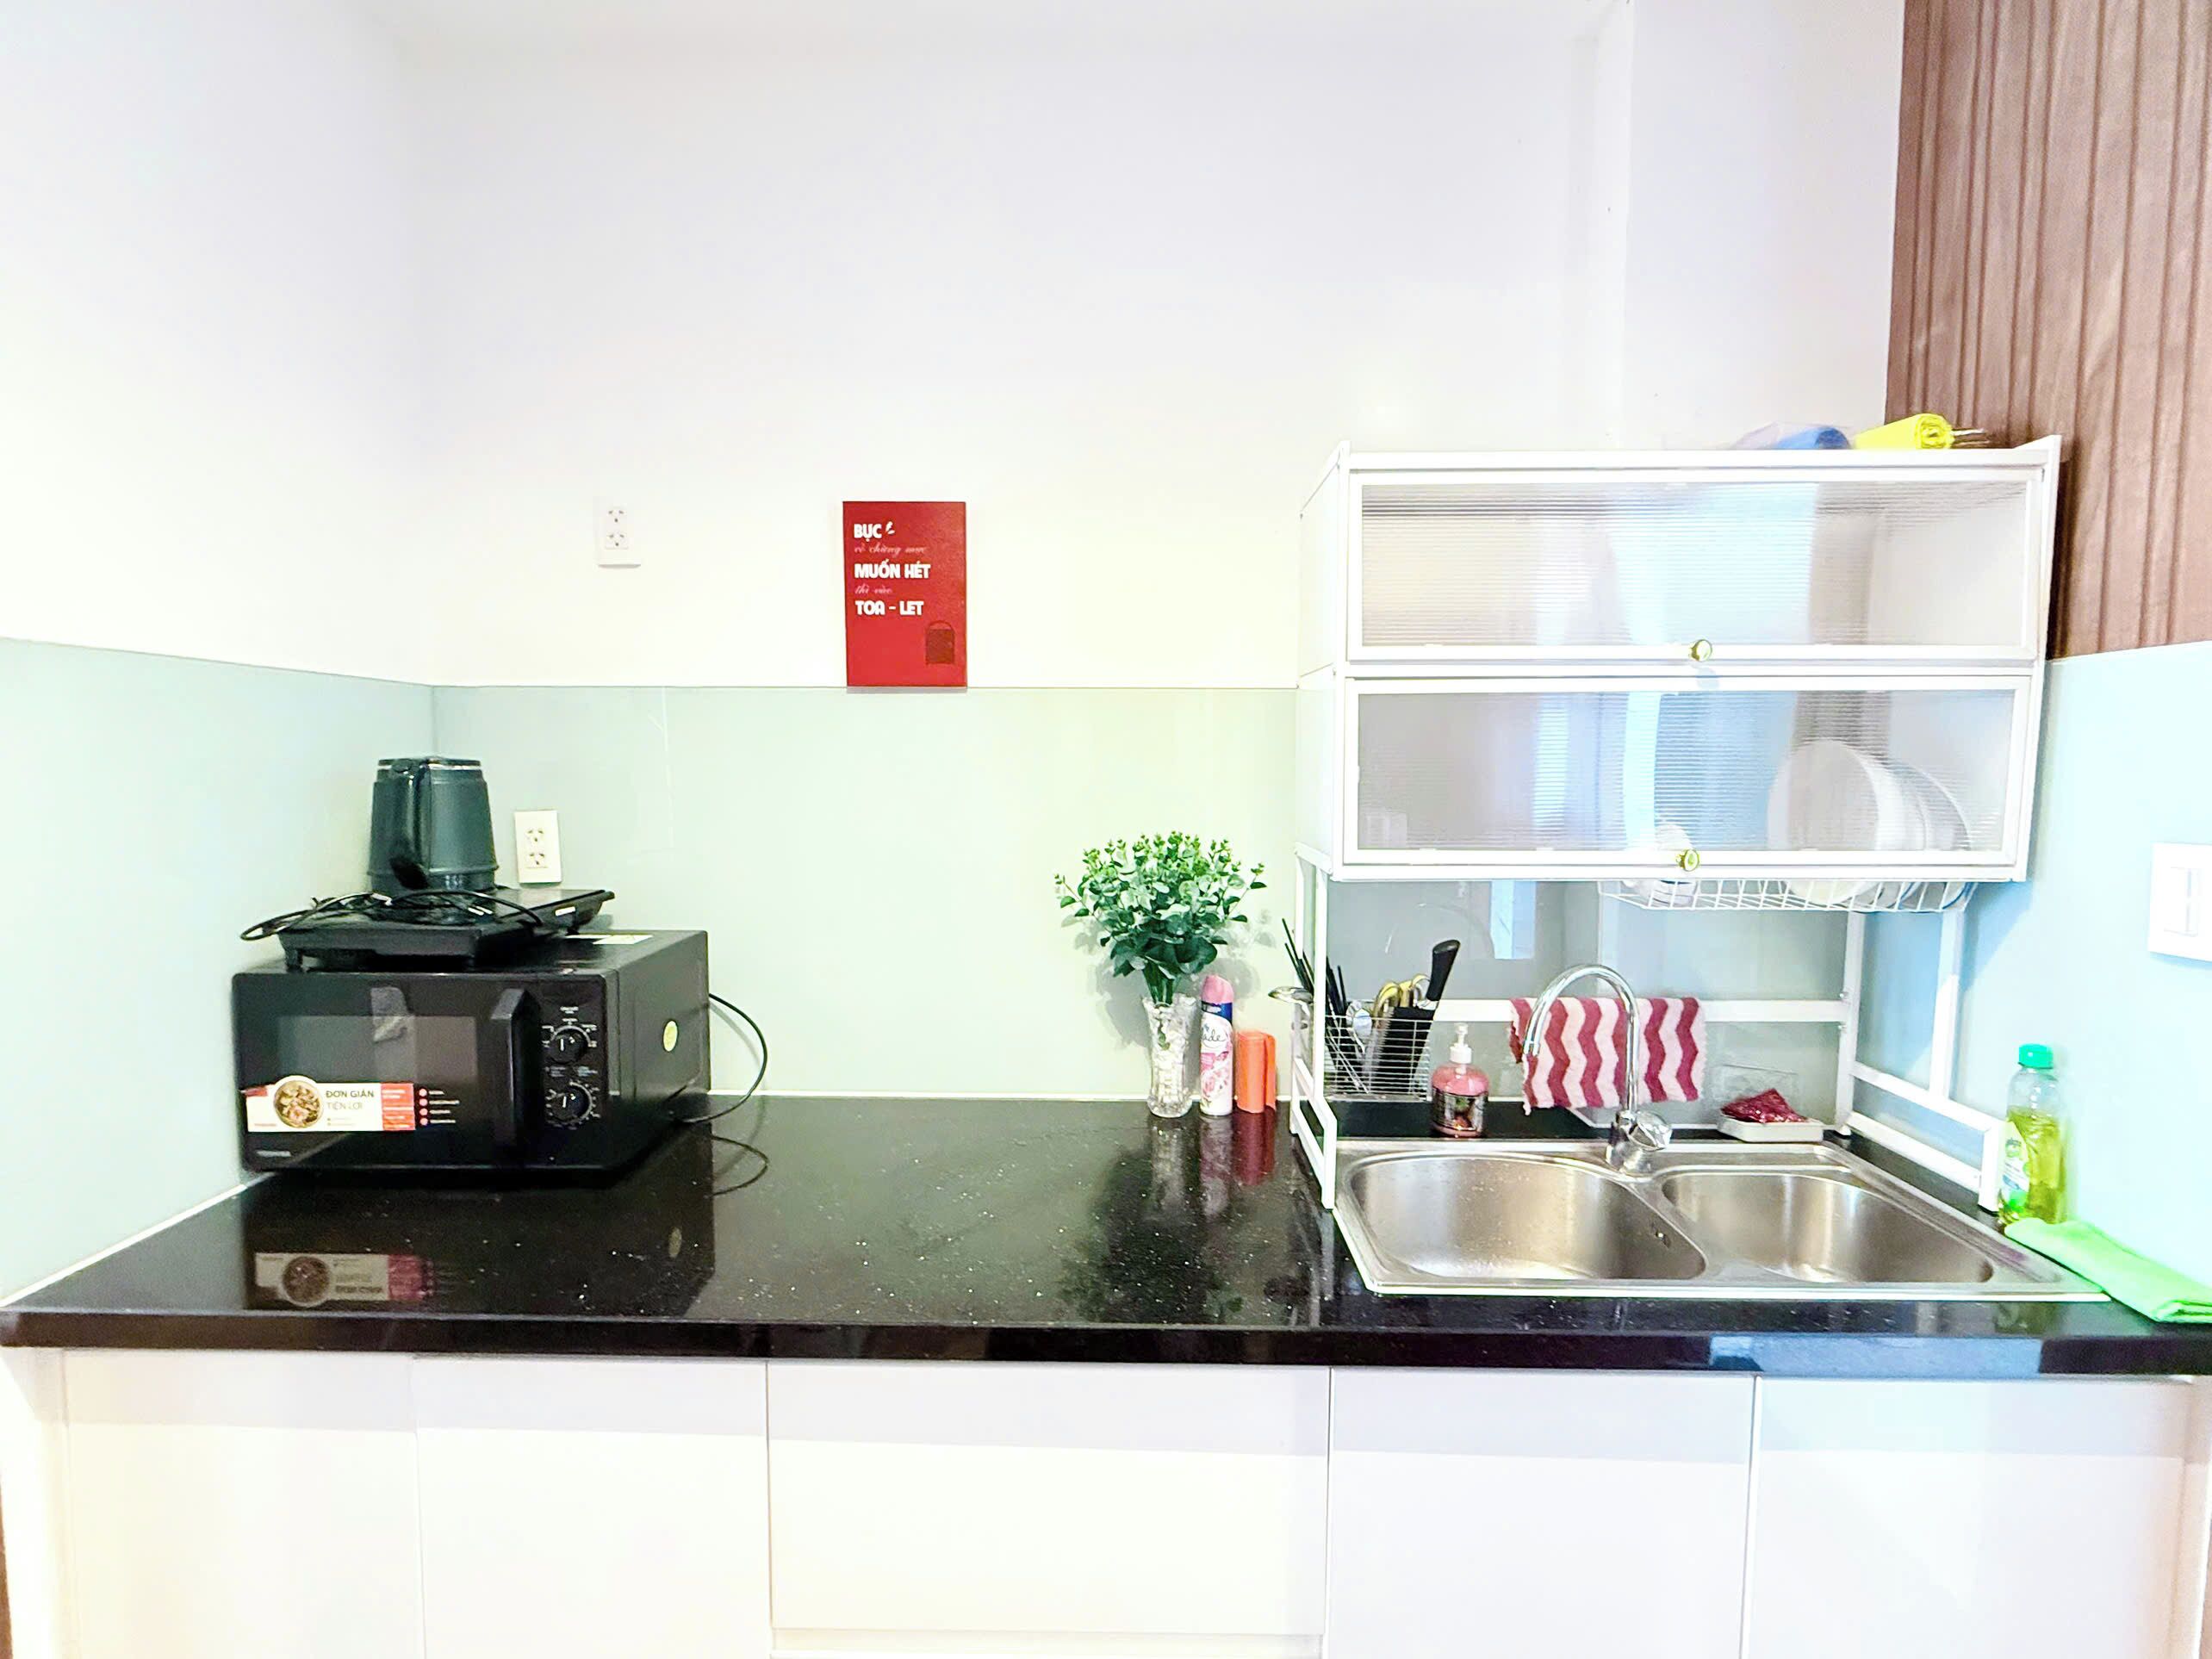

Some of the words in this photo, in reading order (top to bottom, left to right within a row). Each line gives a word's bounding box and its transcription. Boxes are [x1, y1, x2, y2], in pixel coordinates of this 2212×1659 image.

[854, 558, 901, 579] MUỐN
[904, 560, 931, 579] HÉT
[854, 600, 885, 616] TOA
[899, 600, 924, 616] LET
[326, 1090, 347, 1098] ĐƠN
